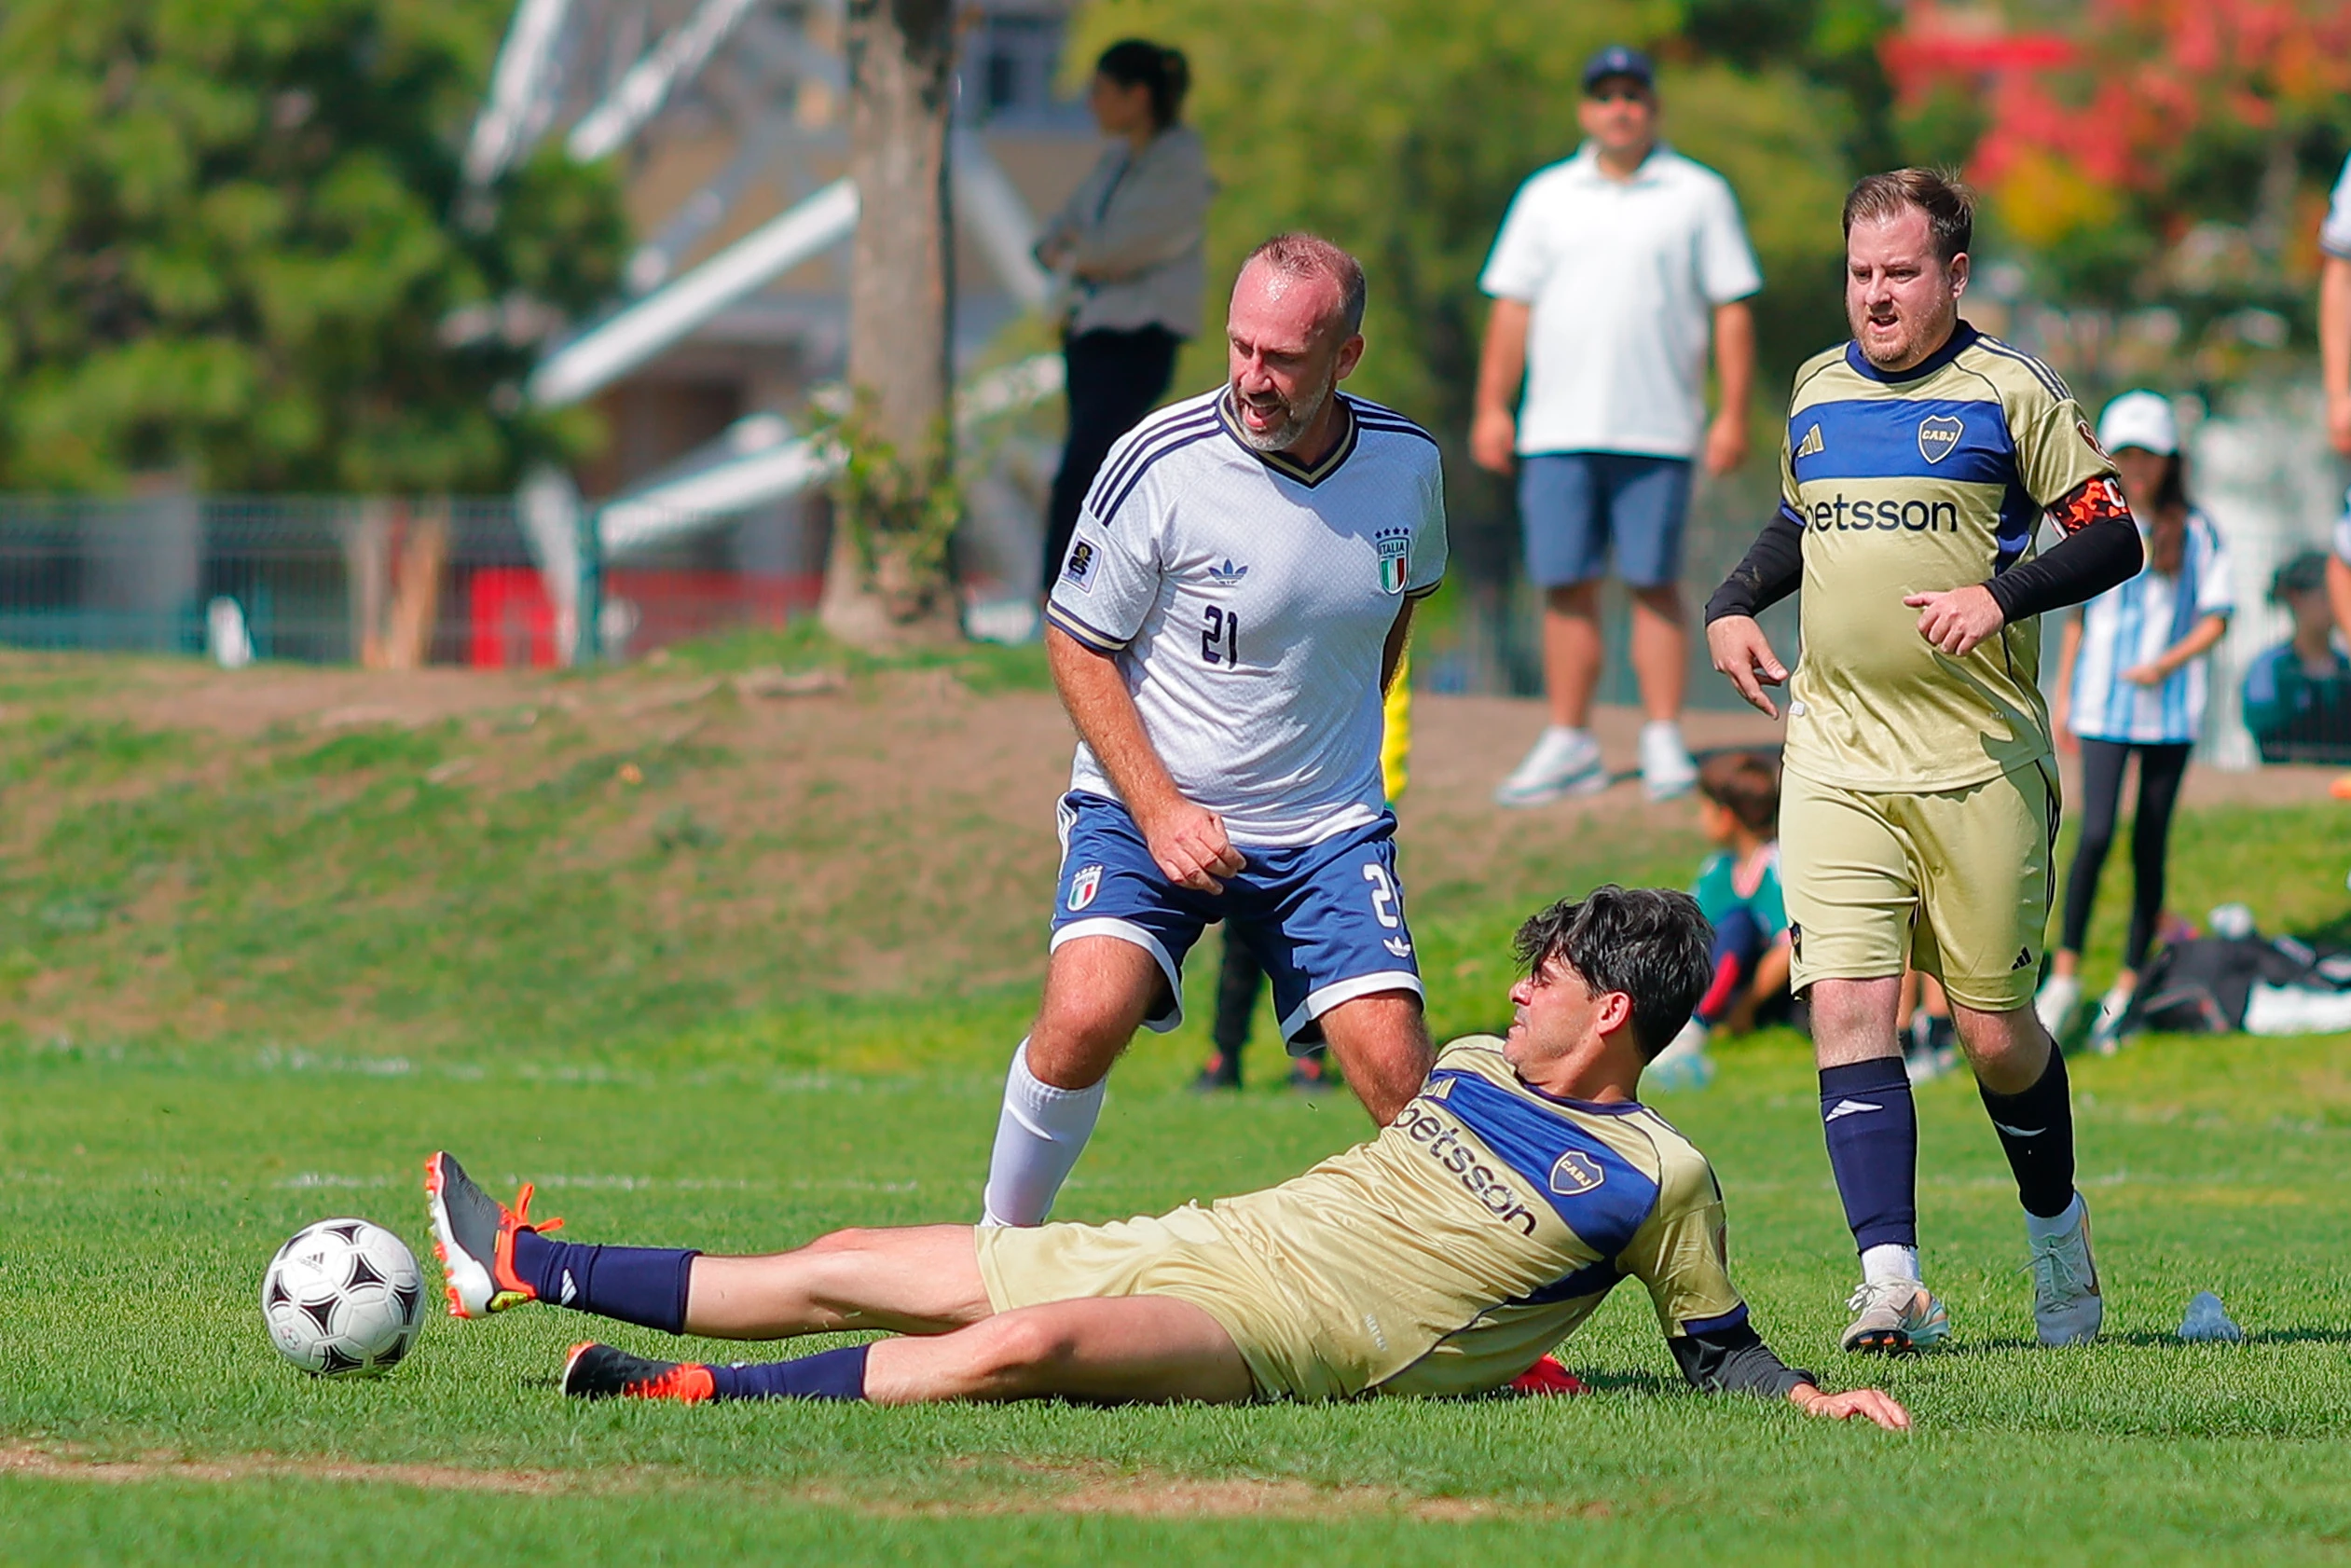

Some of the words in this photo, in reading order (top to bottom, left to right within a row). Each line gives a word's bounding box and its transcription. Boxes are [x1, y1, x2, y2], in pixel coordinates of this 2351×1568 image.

[1921, 430, 1956, 442] CABJ
[2103, 476, 2125, 508] C
[1379, 542, 1406, 556] ITALIA
[1202, 604, 1238, 670] 21
